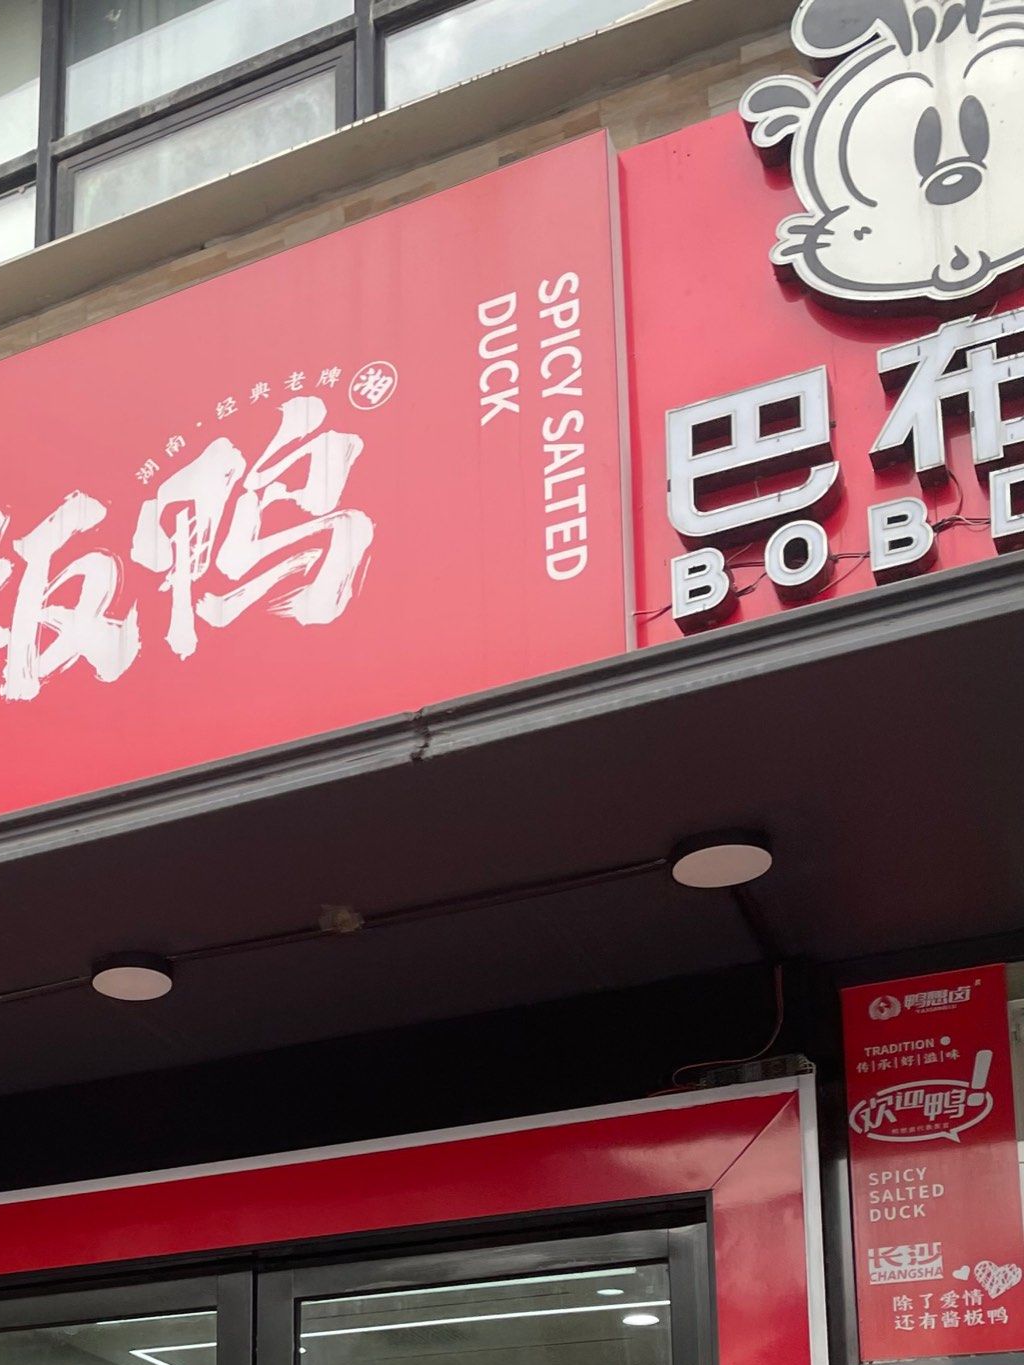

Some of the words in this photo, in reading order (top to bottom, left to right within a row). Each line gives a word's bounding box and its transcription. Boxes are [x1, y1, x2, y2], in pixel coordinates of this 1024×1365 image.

[538, 271, 584, 398] SPICY
[477, 291, 521, 427] DUCK
[541, 409, 588, 582] SALTED
[864, 1037, 936, 1058] TRADITION
[868, 1166, 928, 1187] SPICY
[869, 1183, 945, 1205] SALTED
[869, 1203, 926, 1223] DUCK
[870, 1267, 943, 1283] CHANGSHA
[892, 1288, 985, 1313] 除了爱情
[894, 1305, 1009, 1331] 还有酱板鸭
